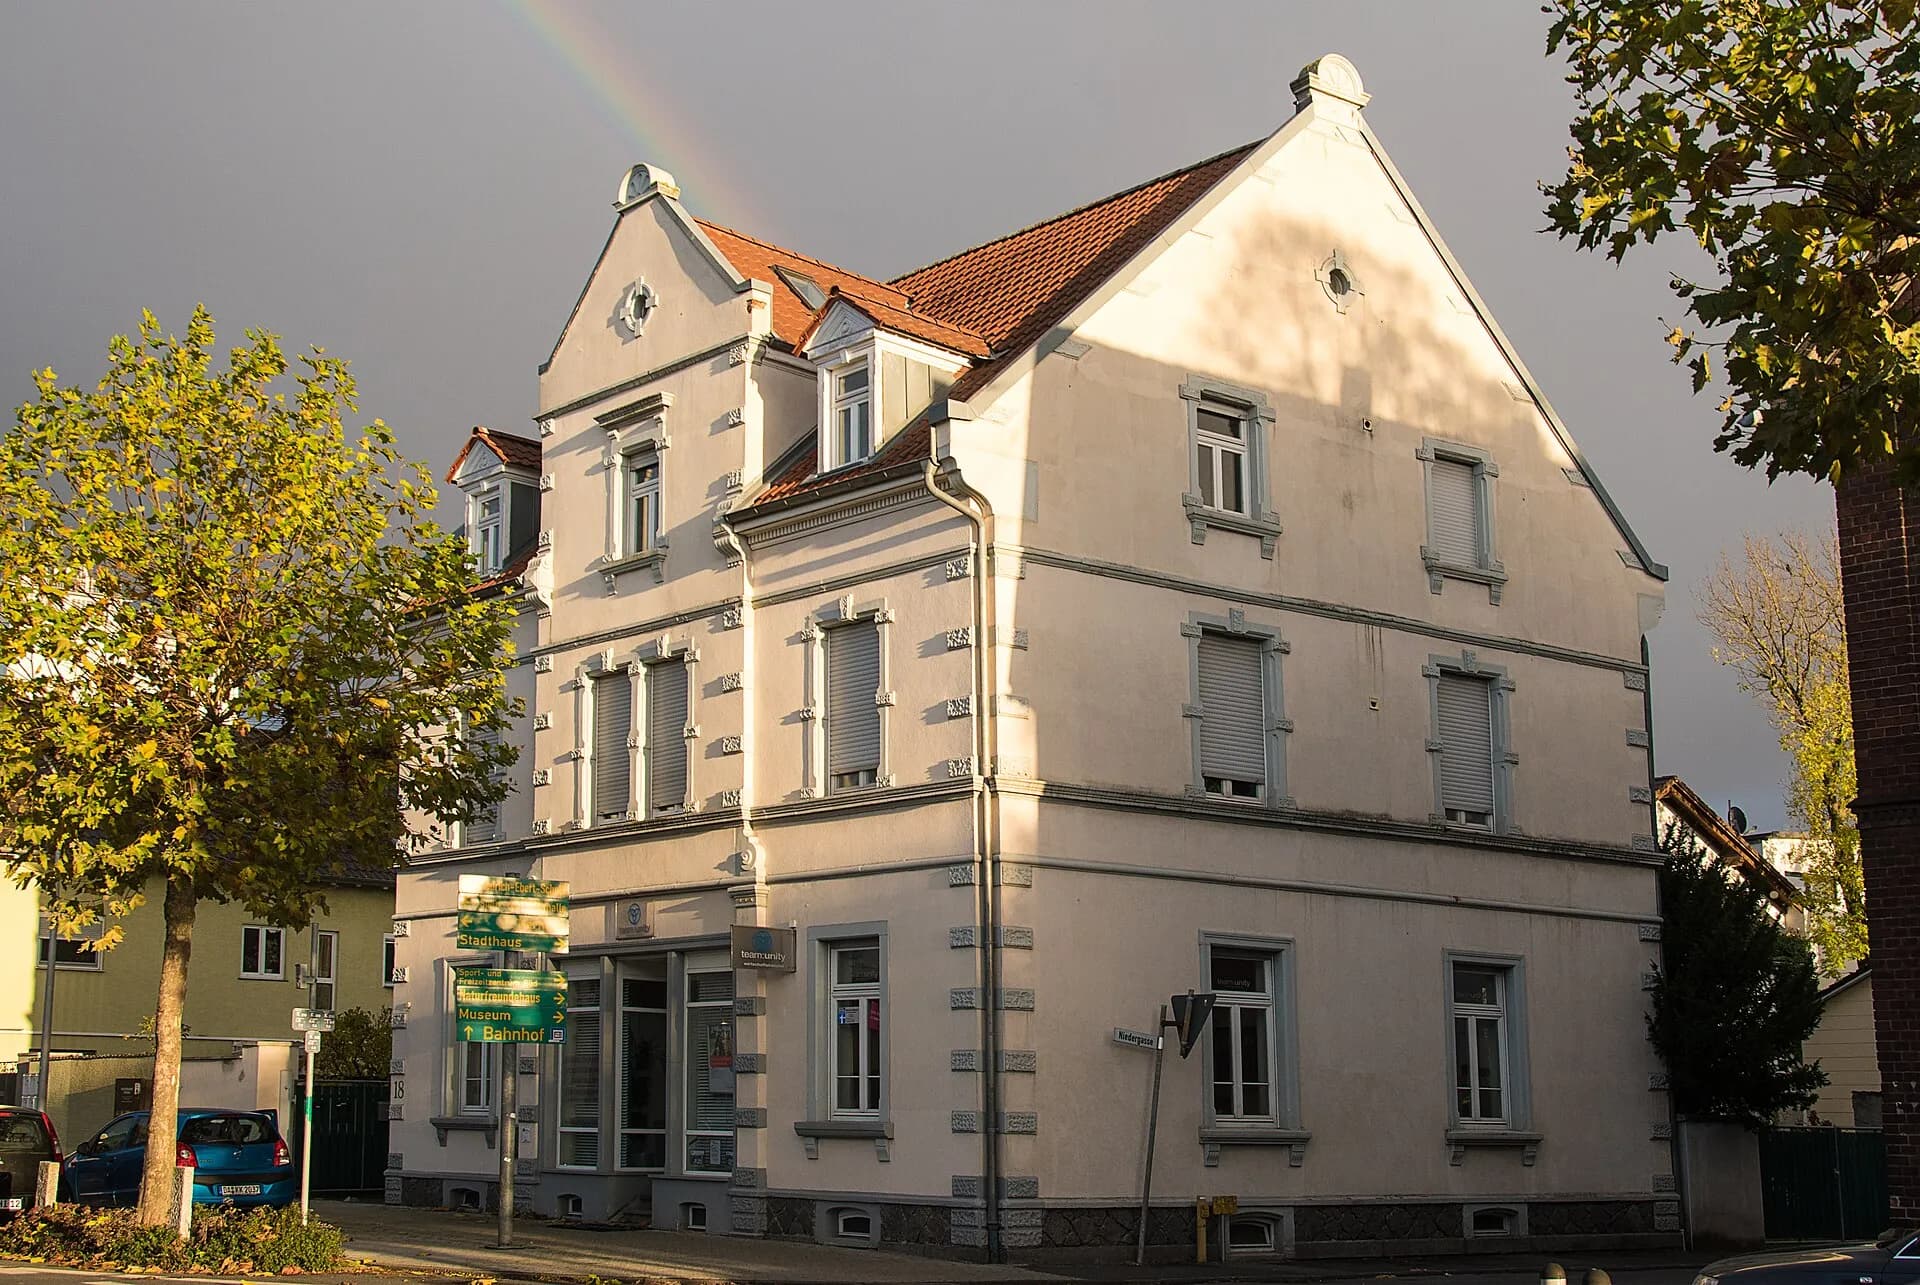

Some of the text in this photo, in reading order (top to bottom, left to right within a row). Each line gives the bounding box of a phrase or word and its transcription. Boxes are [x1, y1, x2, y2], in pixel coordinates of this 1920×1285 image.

[460, 934, 522, 947] Stadthaus
[741, 950, 786, 962] team:unity
[460, 968, 502, 977] Sport- und
[459, 989, 541, 1003] Naturfreundehaus
[459, 1008, 511, 1020] Museum
[483, 1025, 545, 1041] Bahnhof
[1118, 1031, 1154, 1047] Niedergasse
[394, 1080, 405, 1099] 18
